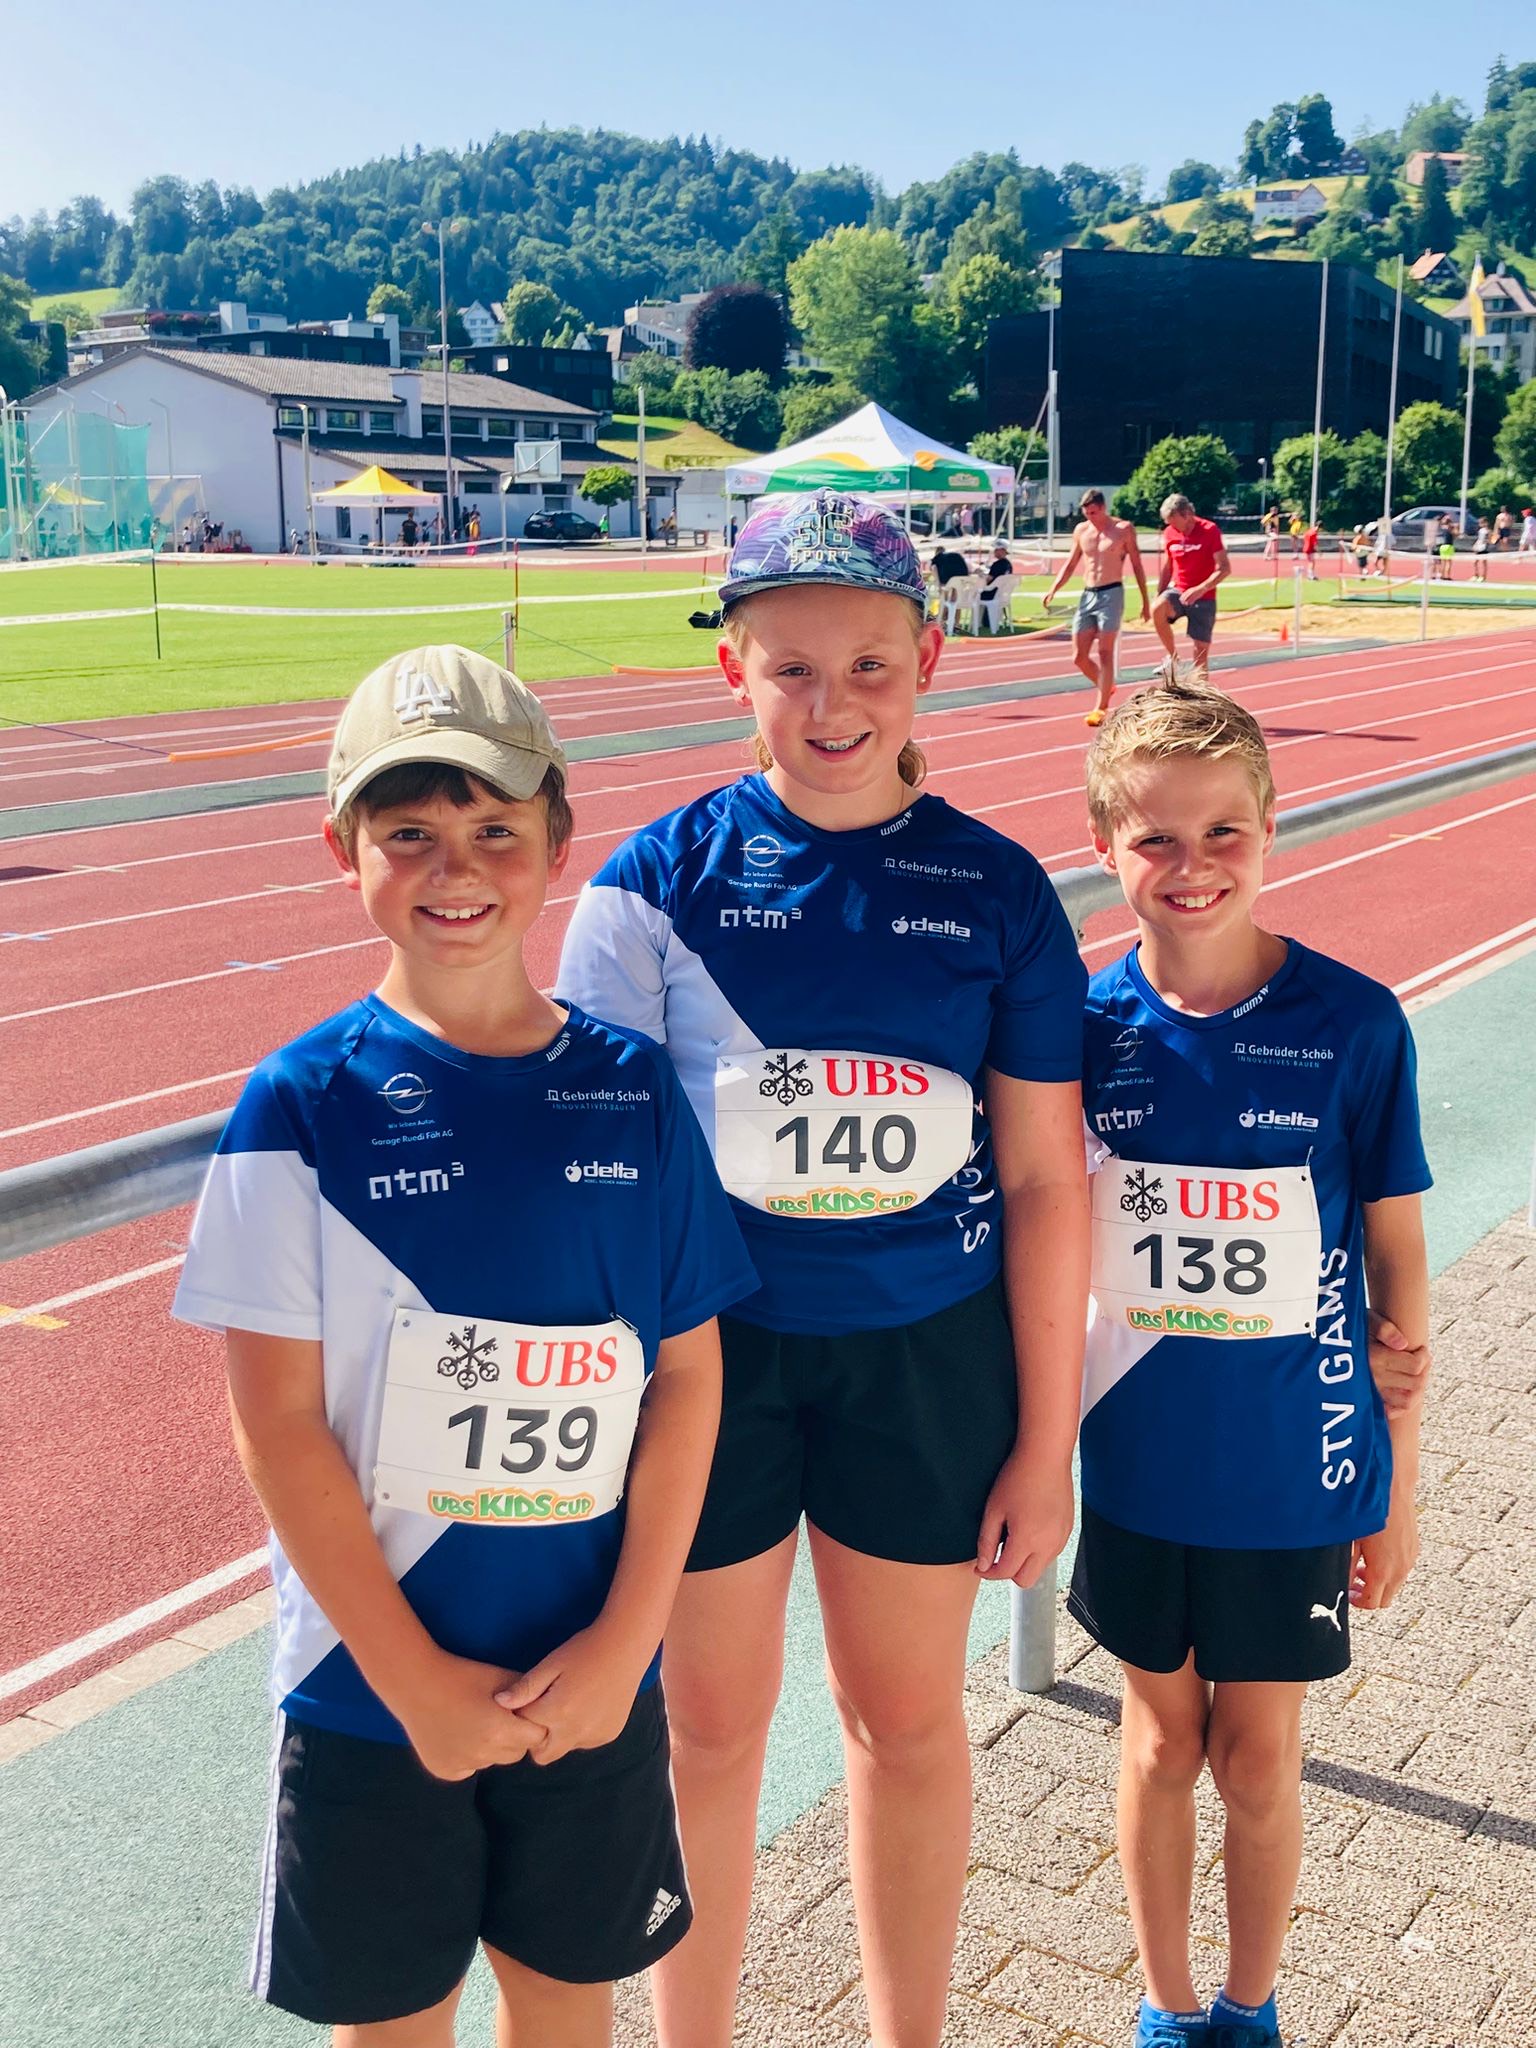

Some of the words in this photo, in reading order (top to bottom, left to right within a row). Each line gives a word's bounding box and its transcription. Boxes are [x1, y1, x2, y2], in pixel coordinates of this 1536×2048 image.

[790, 549, 852, 564] SPORT
[394, 663, 454, 725] LA
[898, 860, 949, 877] Gebrüder
[951, 867, 984, 880] Schöb
[910, 917, 971, 938] delta
[1248, 1044, 1299, 1059] Gebrüder
[1301, 1048, 1334, 1060] Schöb
[821, 1058, 930, 1097] UBS
[562, 1089, 615, 1101] Gebrüder
[617, 1089, 650, 1102] Schöb
[1257, 1109, 1319, 1128] delta
[371, 1137, 401, 1146] Garage
[402, 1132, 425, 1143] Ruedi
[441, 1128, 454, 1138] AG
[775, 1114, 917, 1174] 140
[583, 1160, 638, 1179] delta
[770, 1199, 808, 1213] UBS
[811, 1192, 876, 1213] KIDS
[878, 1195, 915, 1210] CUP
[1176, 1178, 1281, 1222] UBS
[1132, 1233, 1267, 1296] 138
[1130, 1311, 1163, 1329] UBS
[1165, 1308, 1230, 1332] KIDS
[1231, 1318, 1270, 1334] CUP
[1318, 1247, 1354, 1385] GAMS
[515, 1336, 619, 1387] UBS
[447, 1404, 598, 1474] 139
[1321, 1402, 1356, 1491] STV
[432, 1495, 474, 1516] UBS
[480, 1493, 553, 1518] KIDS
[555, 1497, 591, 1515] CUP
[646, 1894, 682, 1936] adidas
